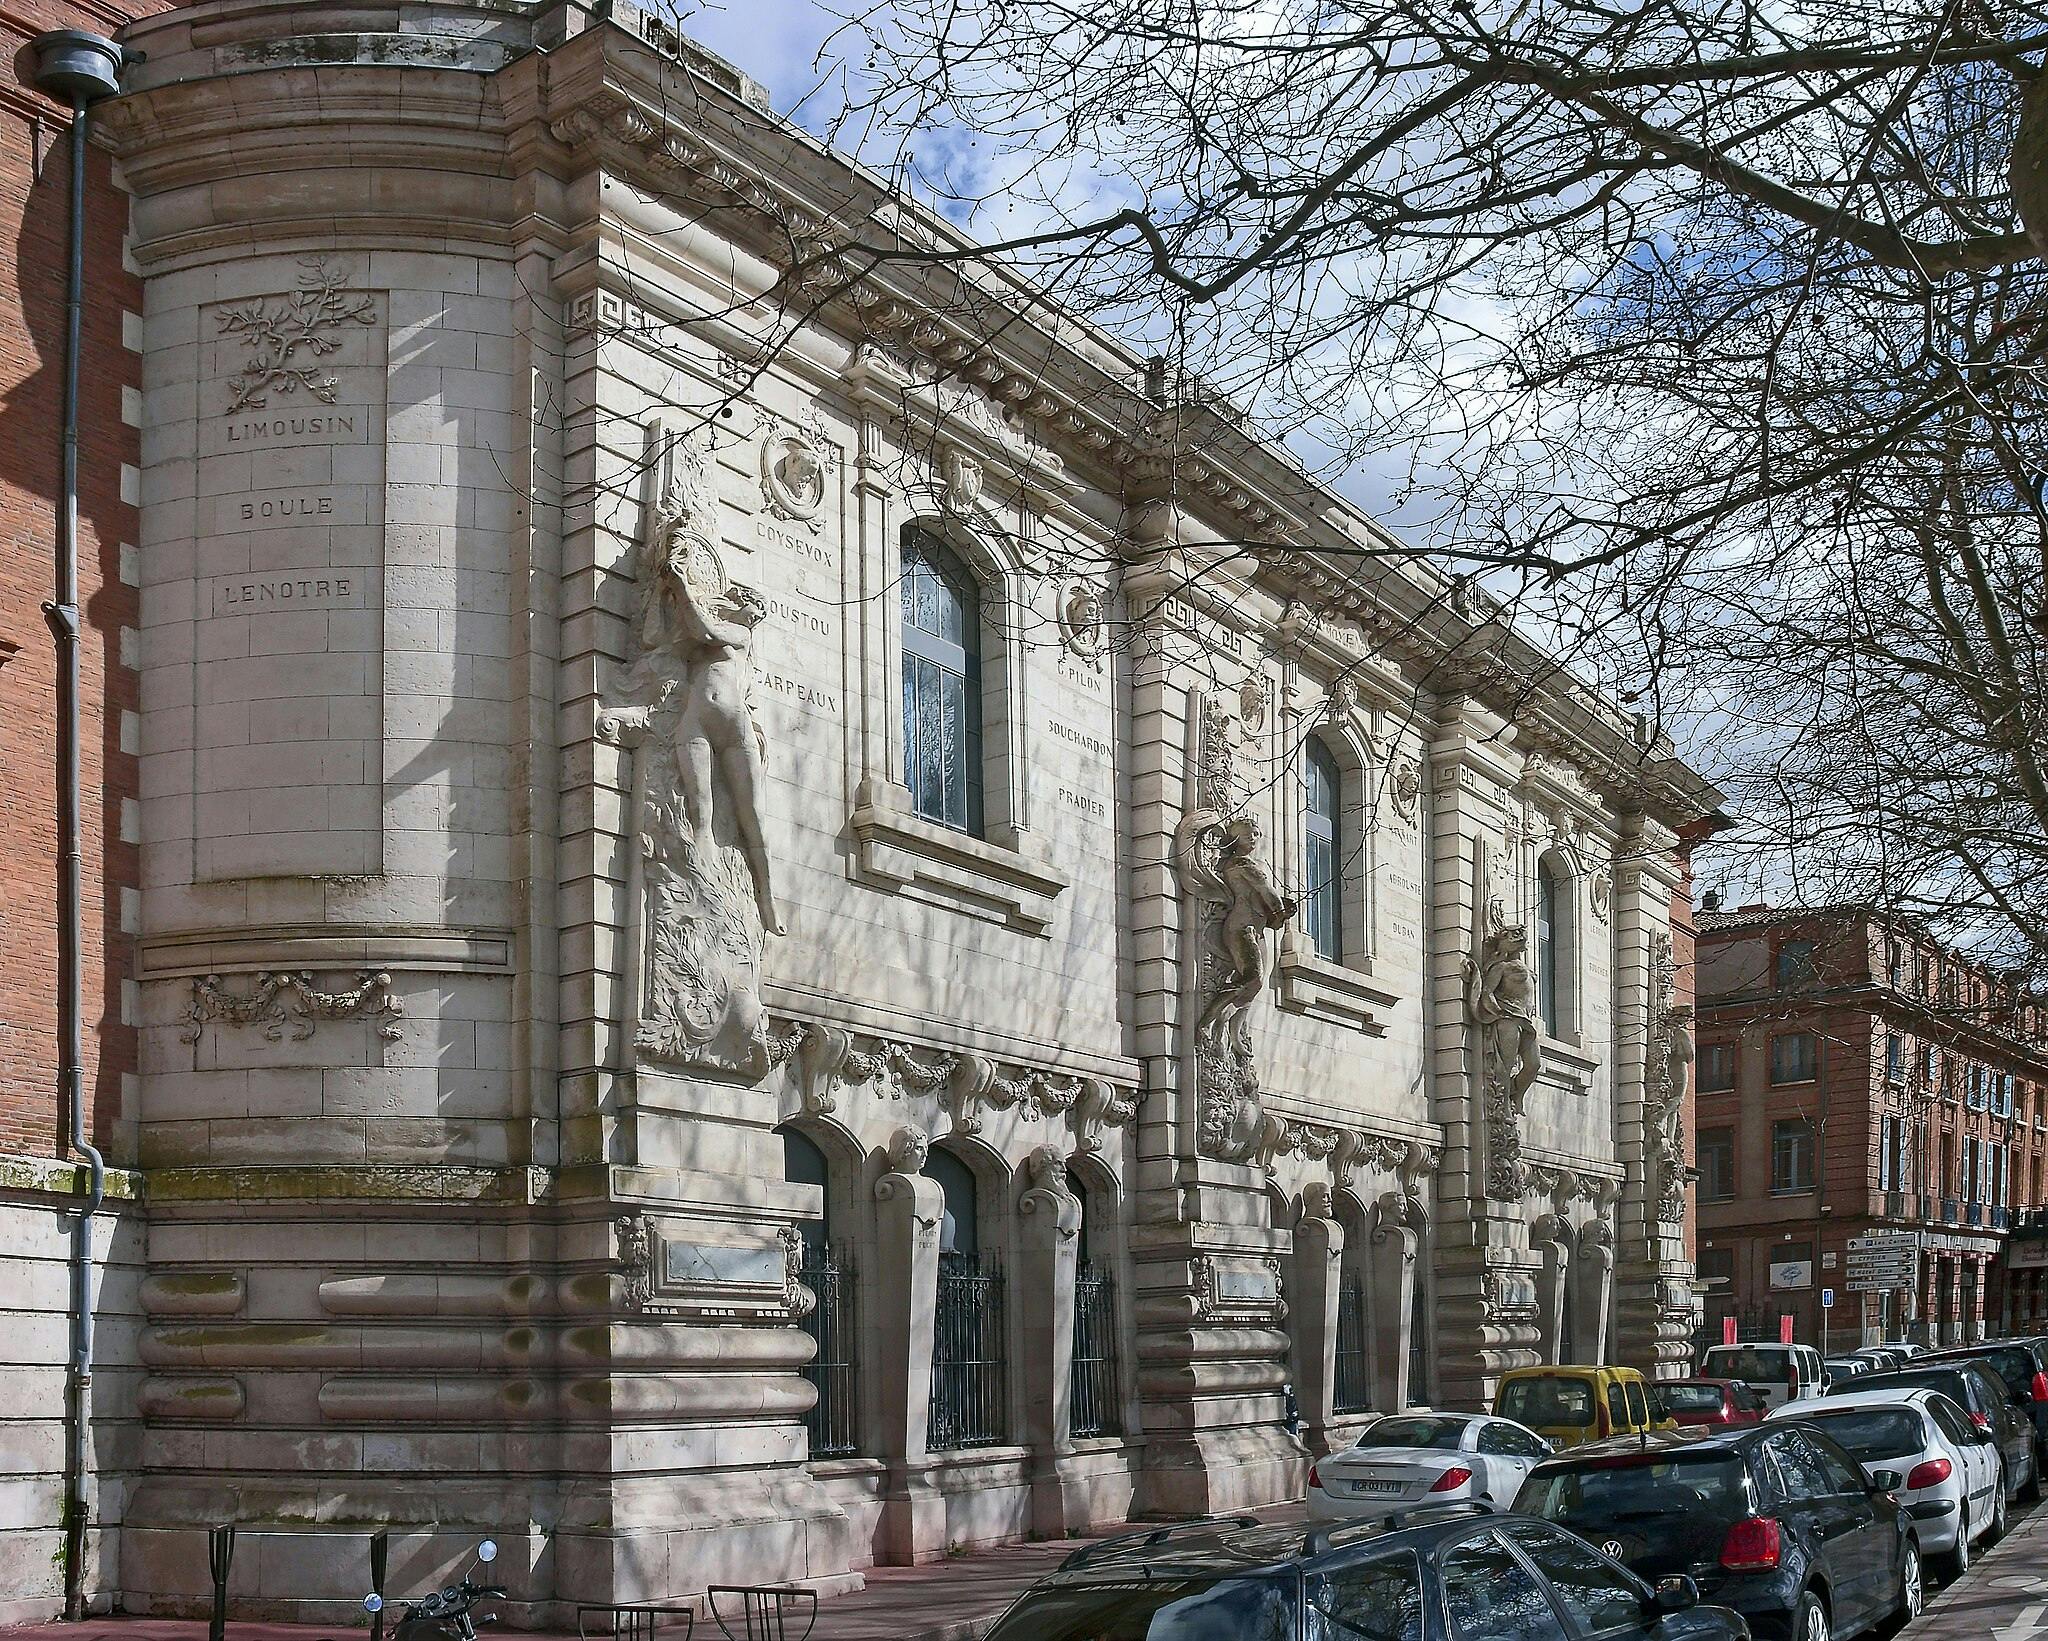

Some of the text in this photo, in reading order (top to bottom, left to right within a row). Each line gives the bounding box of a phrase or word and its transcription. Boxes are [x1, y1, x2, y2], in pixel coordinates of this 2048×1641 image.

[227, 417, 353, 441] LIMOUSIN
[241, 498, 333, 519] BOULE
[756, 521, 832, 568] COYSEVOX
[225, 580, 350, 603] LENOTRE
[768, 600, 830, 636] OUSTOU
[1069, 667, 1101, 693] PILON
[1048, 719, 1113, 759] BOUCHARDON
[1058, 787, 1105, 818] PRADIER
